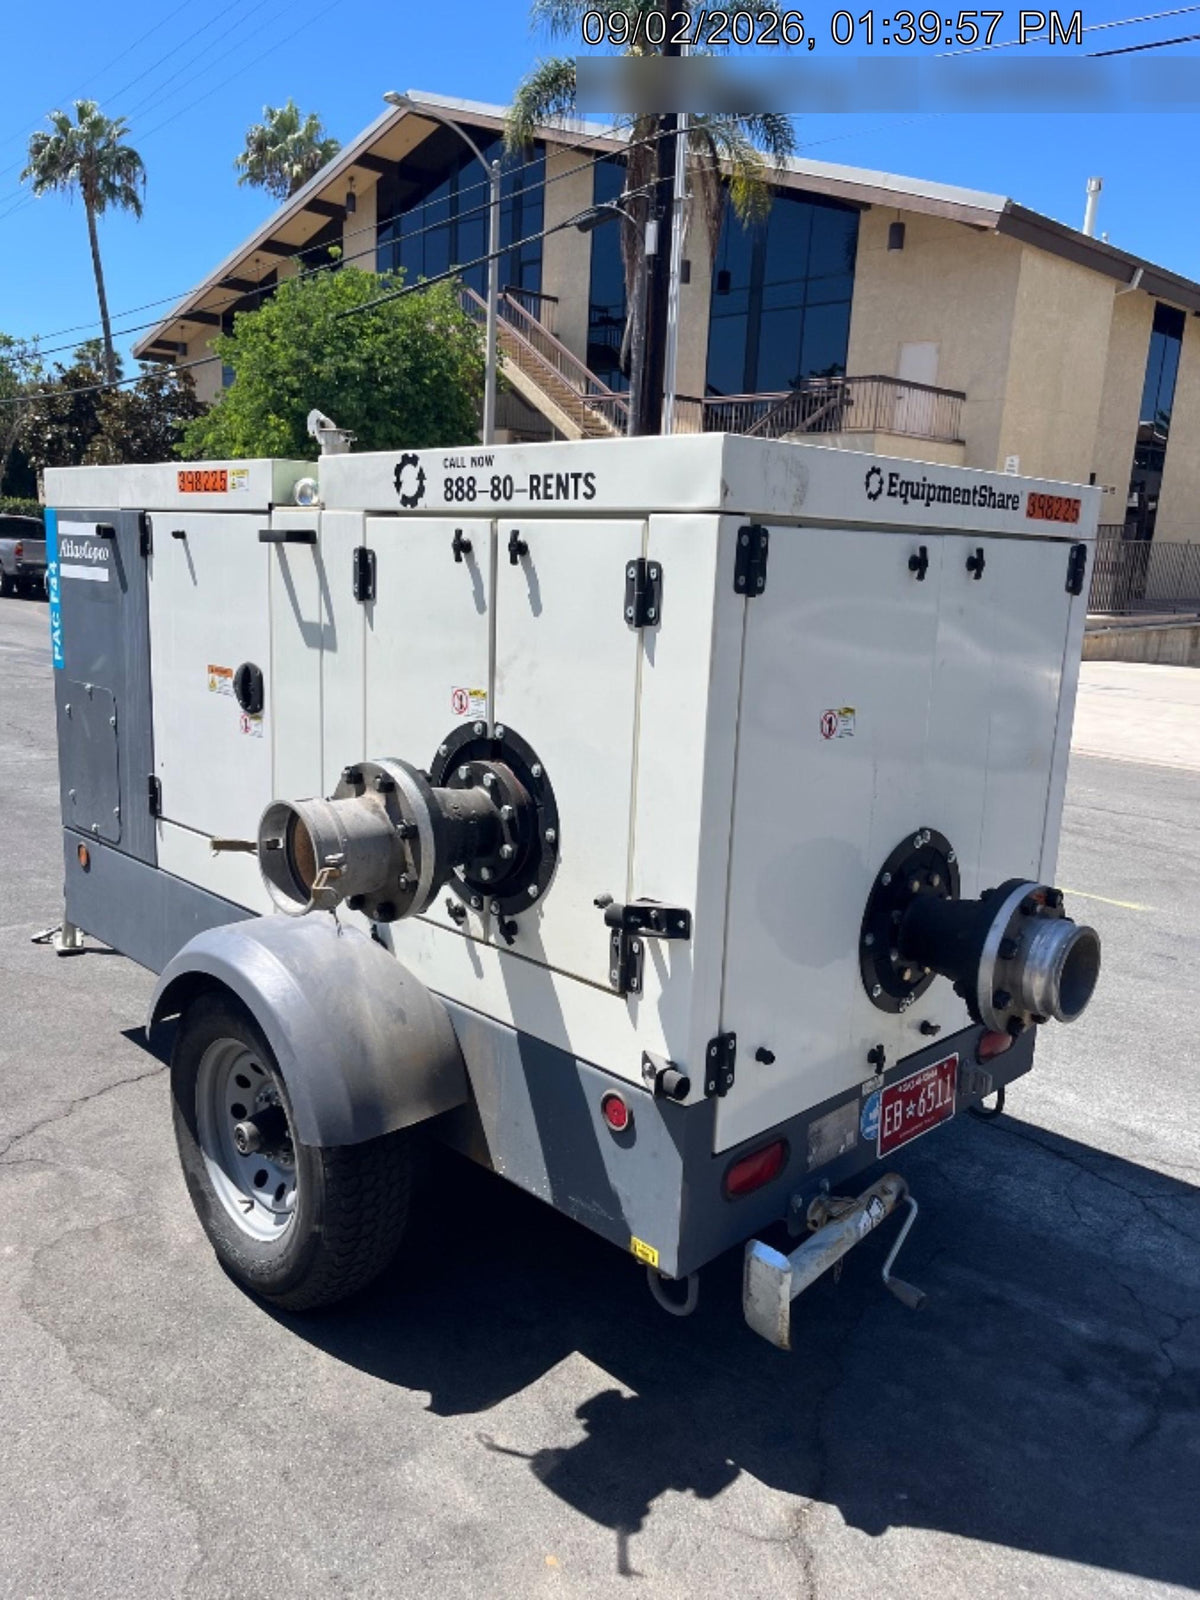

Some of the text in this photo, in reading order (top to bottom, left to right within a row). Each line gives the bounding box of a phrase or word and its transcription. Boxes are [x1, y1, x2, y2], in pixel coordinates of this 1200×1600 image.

[443, 454, 495, 469] CALL NOW
[443, 471, 597, 502] 888-80-RENTS
[886, 471, 1021, 511] EquipmentShare
[883, 1099, 903, 1138] EB
[917, 1073, 952, 1118] 6511
